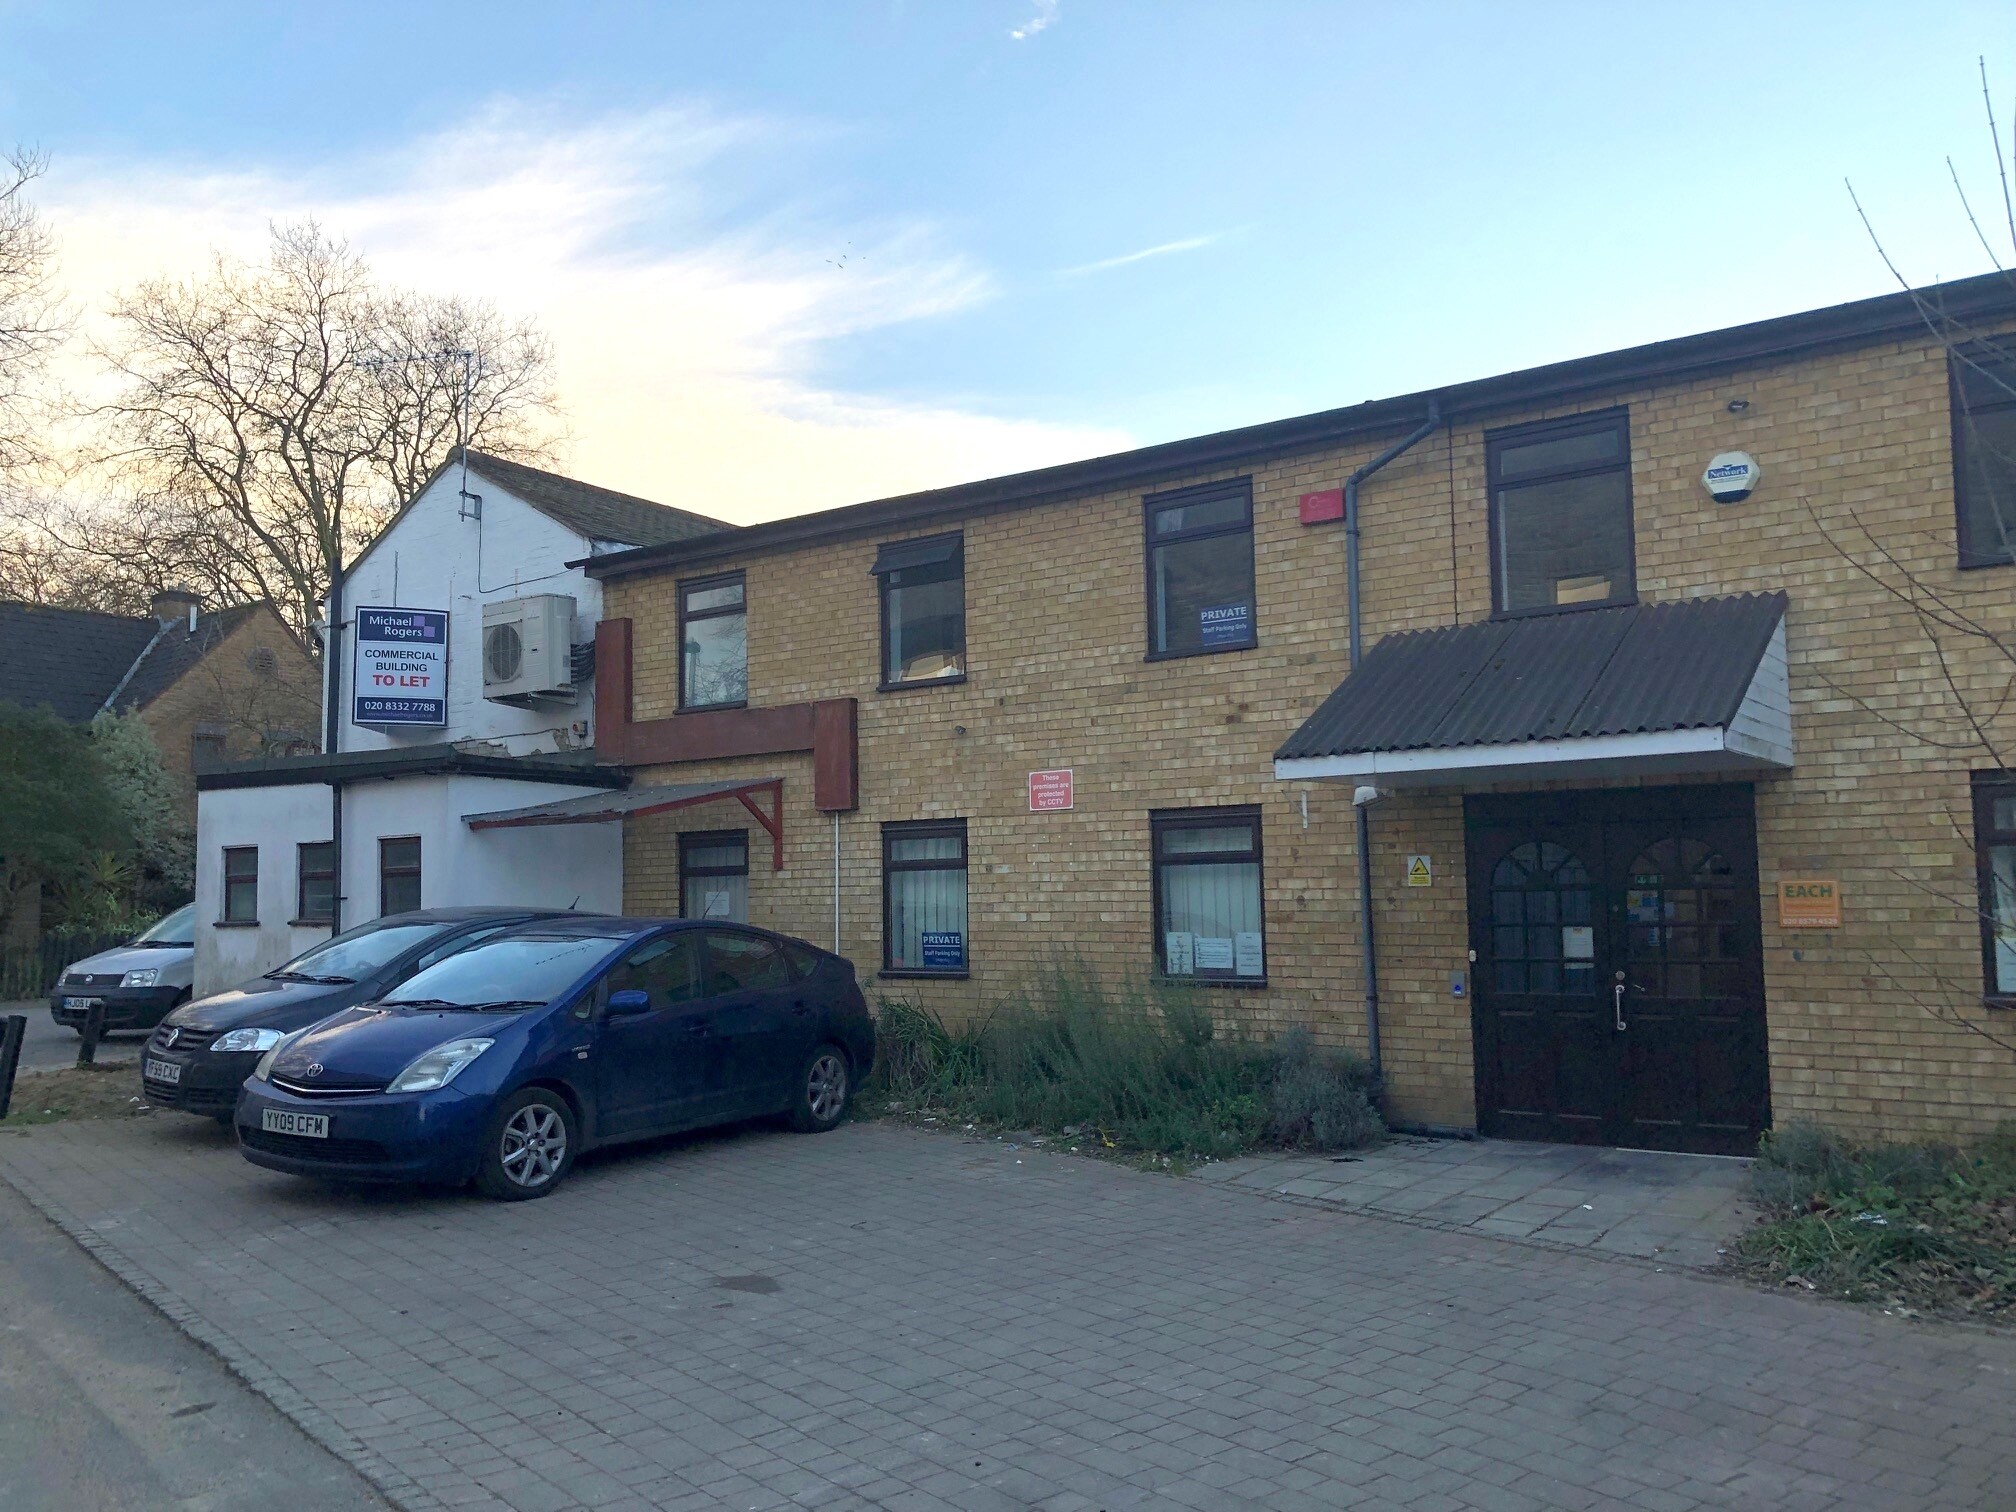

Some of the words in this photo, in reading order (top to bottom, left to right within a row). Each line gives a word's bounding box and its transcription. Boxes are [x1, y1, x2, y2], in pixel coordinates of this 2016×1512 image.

[1710, 467, 1747, 479] Network
[1201, 606, 1247, 620] PRIVATE
[369, 616, 412, 626] Michael
[384, 626, 422, 638] Rogers
[365, 649, 438, 661] COMMERCIAL
[376, 662, 428, 672] BUILDING
[372, 674, 395, 686] TO
[400, 675, 430, 687] LET
[364, 701, 383, 710] 020
[385, 701, 410, 711] 8332
[412, 702, 436, 712] 7788
[1032, 783, 1059, 791] premises
[1037, 790, 1065, 799] protected
[1785, 885, 1833, 897] EACH
[923, 936, 961, 944] PRIVATE
[266, 1111, 295, 1131] YY09
[297, 1115, 324, 1135] CFM
